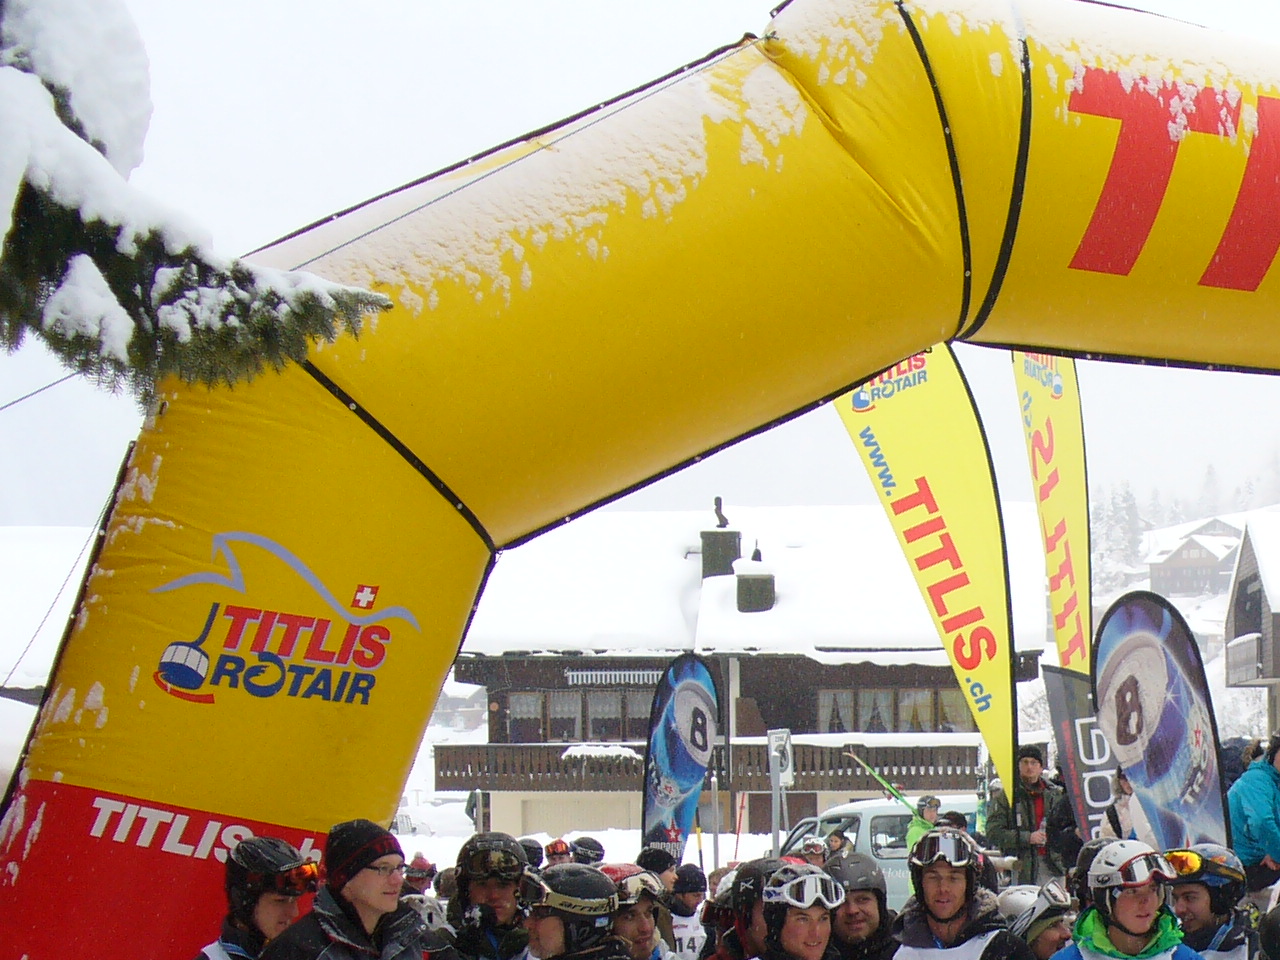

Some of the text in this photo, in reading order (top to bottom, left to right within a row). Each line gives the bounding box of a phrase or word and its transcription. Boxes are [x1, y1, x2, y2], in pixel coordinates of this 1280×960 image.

[871, 370, 928, 401] ROTAIR
[222, 605, 393, 671] TITLIS
[210, 652, 376, 705] ROTAIR
[676, 937, 697, 954] 14
